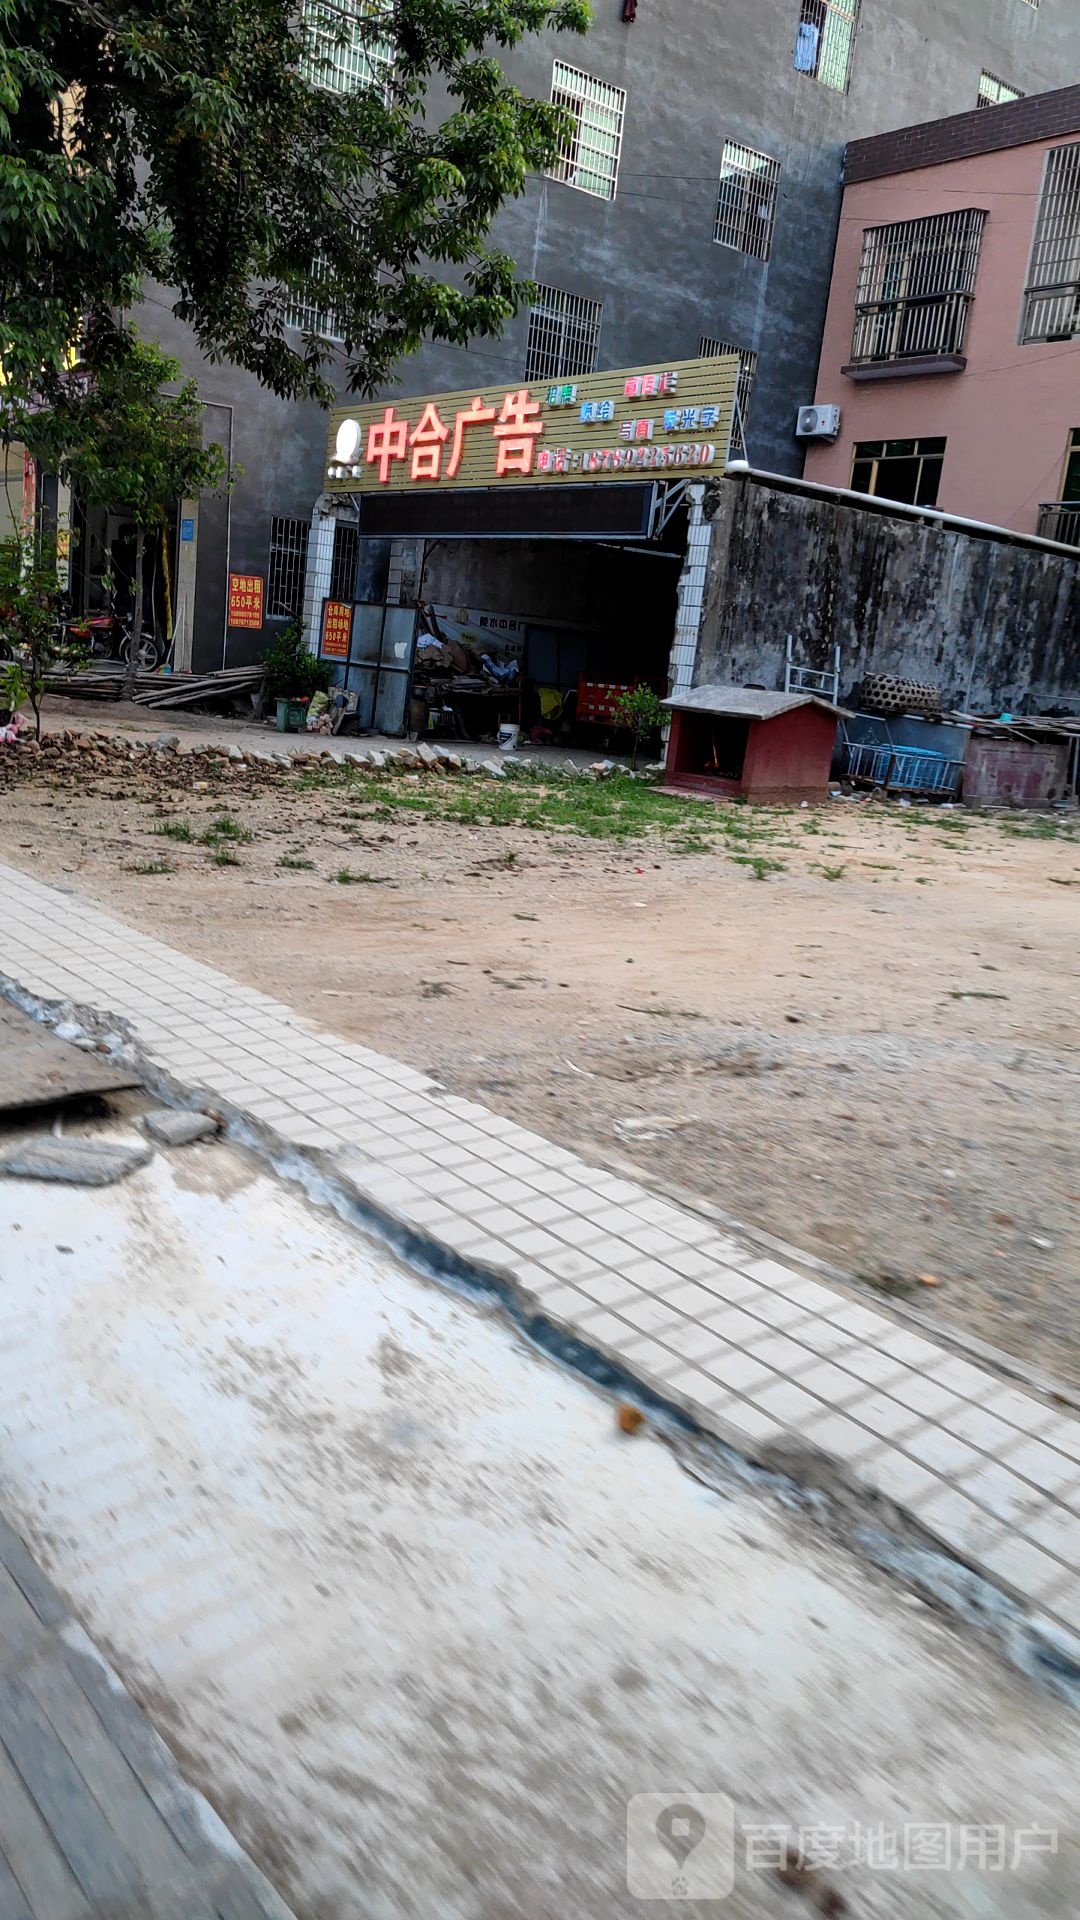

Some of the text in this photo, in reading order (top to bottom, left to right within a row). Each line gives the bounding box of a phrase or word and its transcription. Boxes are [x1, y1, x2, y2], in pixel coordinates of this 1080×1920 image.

[624, 371, 679, 398] 宣传栏
[580, 400, 615, 423] 喷绘
[663, 406, 721, 432] 发光字
[366, 389, 545, 483] 中合广告
